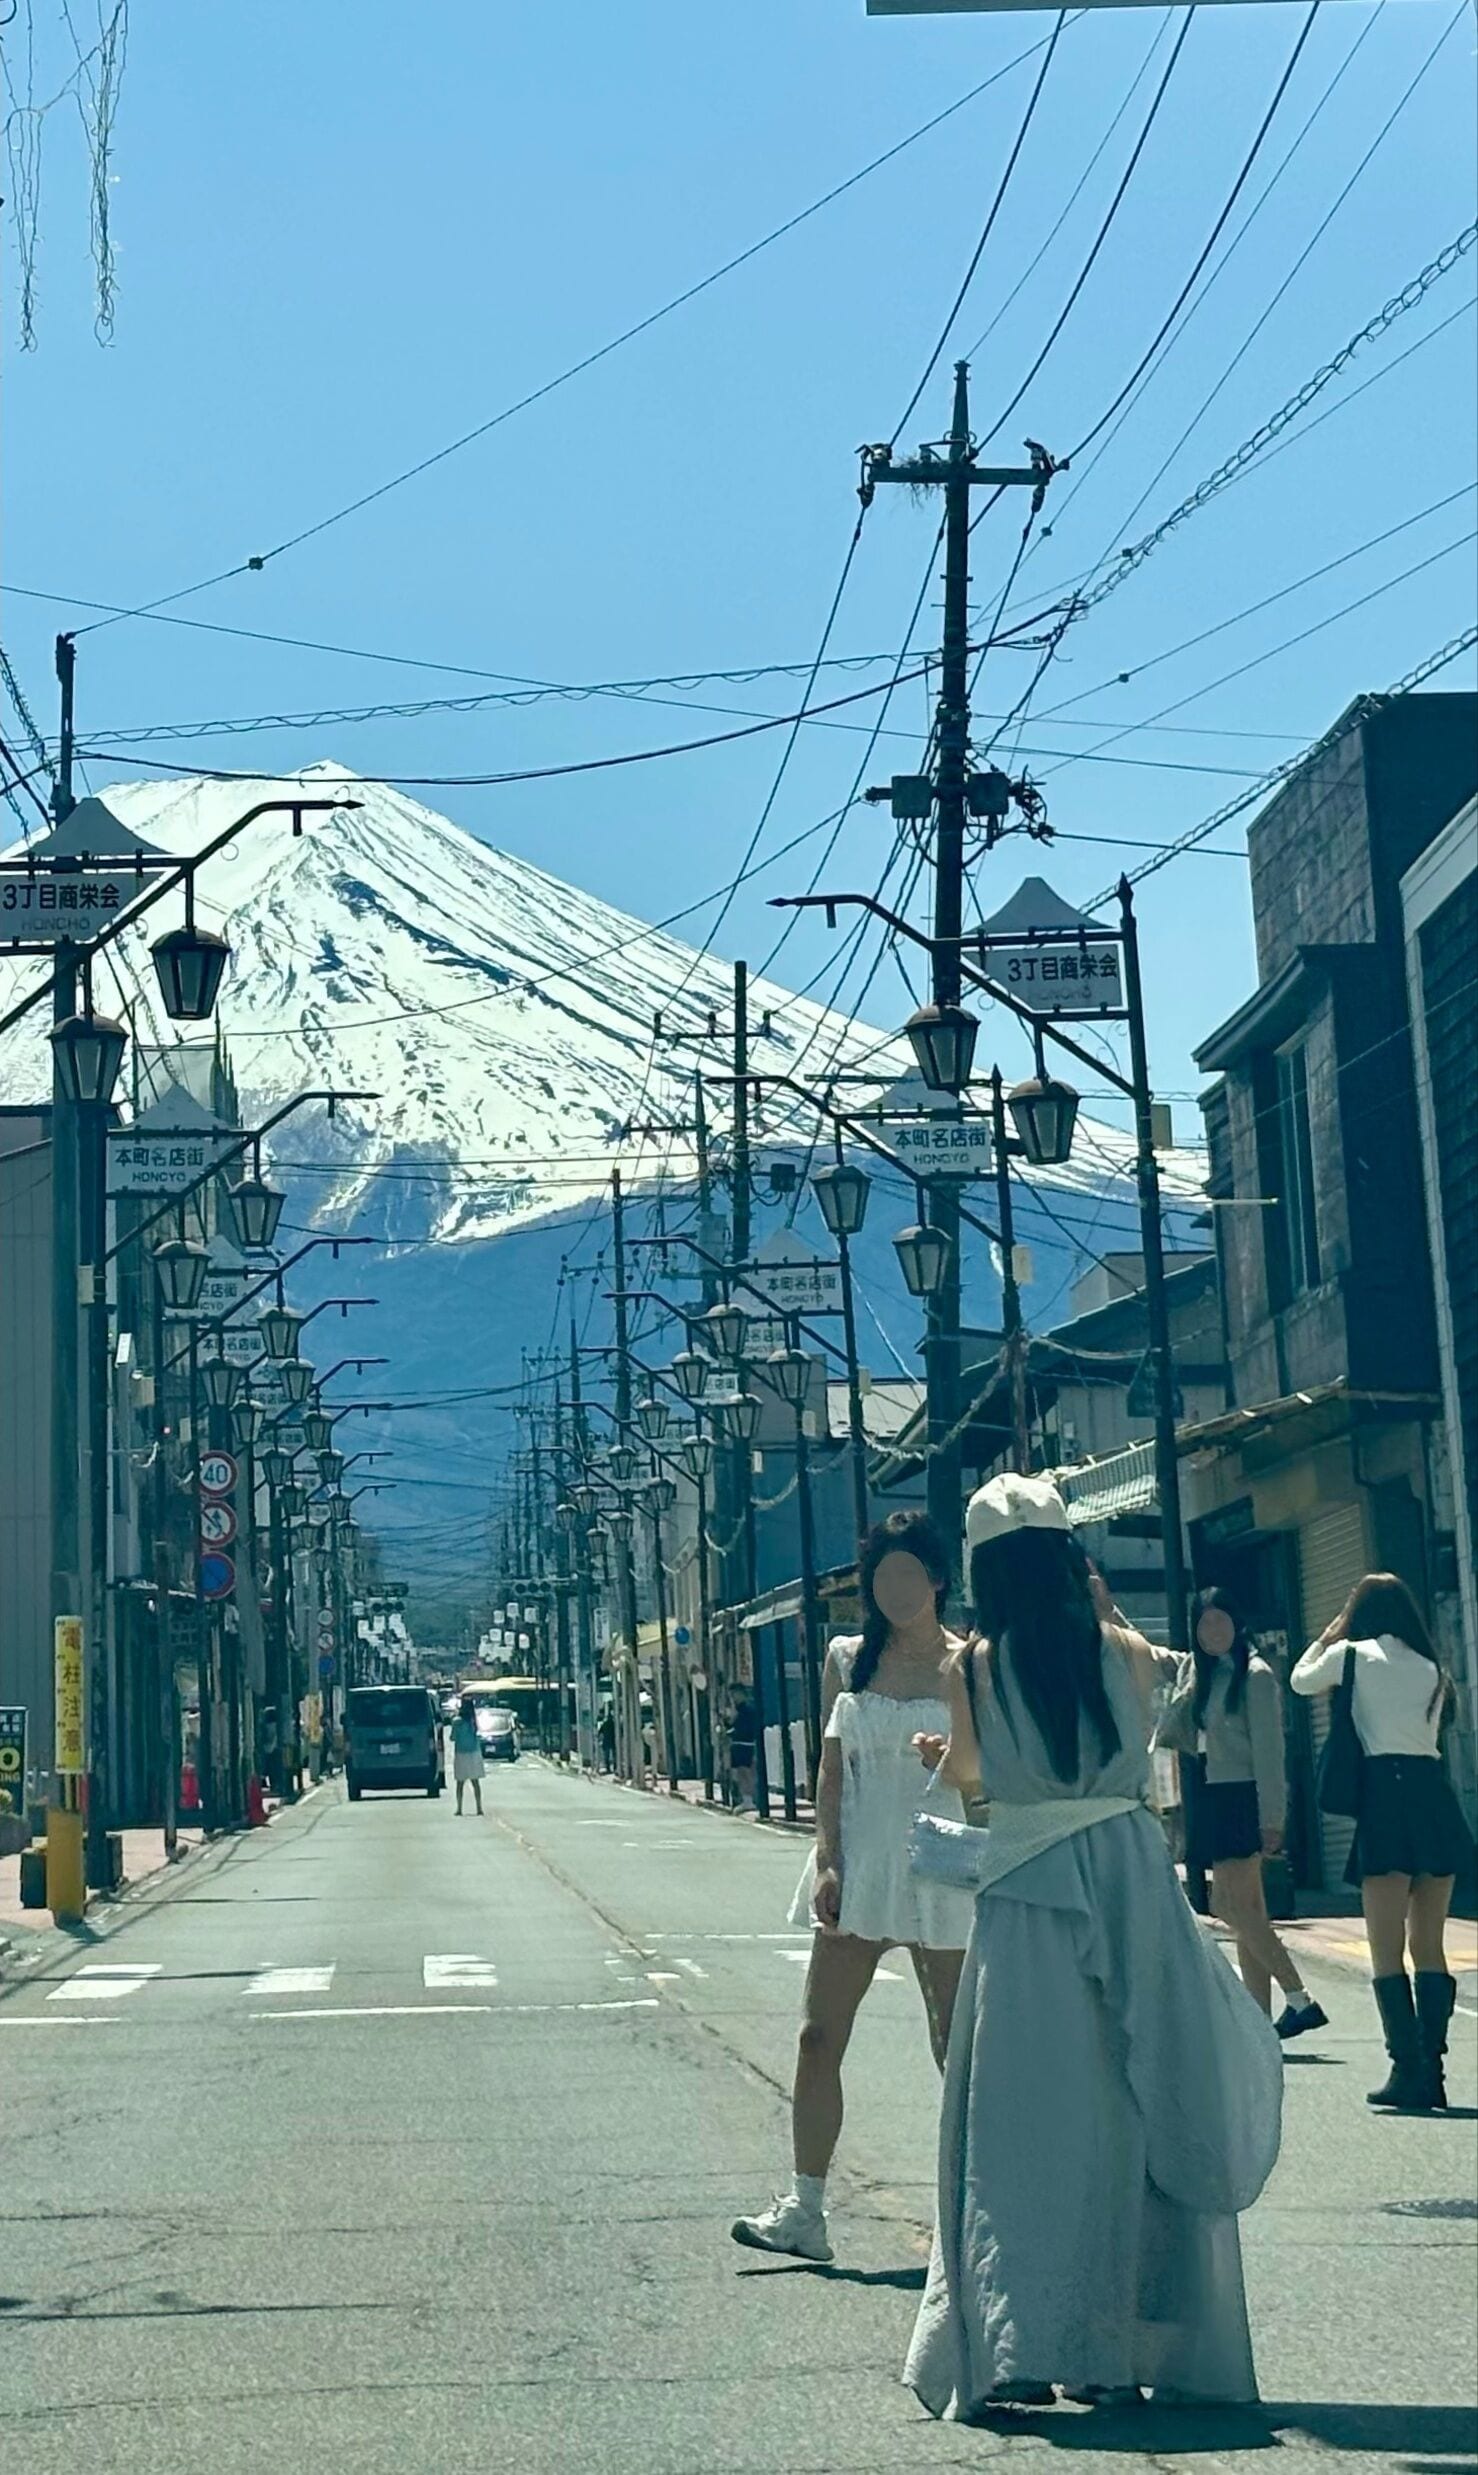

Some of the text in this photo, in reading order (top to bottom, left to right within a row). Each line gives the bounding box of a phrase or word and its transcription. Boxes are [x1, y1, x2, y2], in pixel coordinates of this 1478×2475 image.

[3, 883, 120, 910] 3丁目商栄会
[1008, 953, 1118, 982] 3丁目商栄会
[894, 1126, 986, 1149] 本町名店街
[115, 1147, 204, 1167] 本町名店街
[203, 1464, 229, 1484] 40
